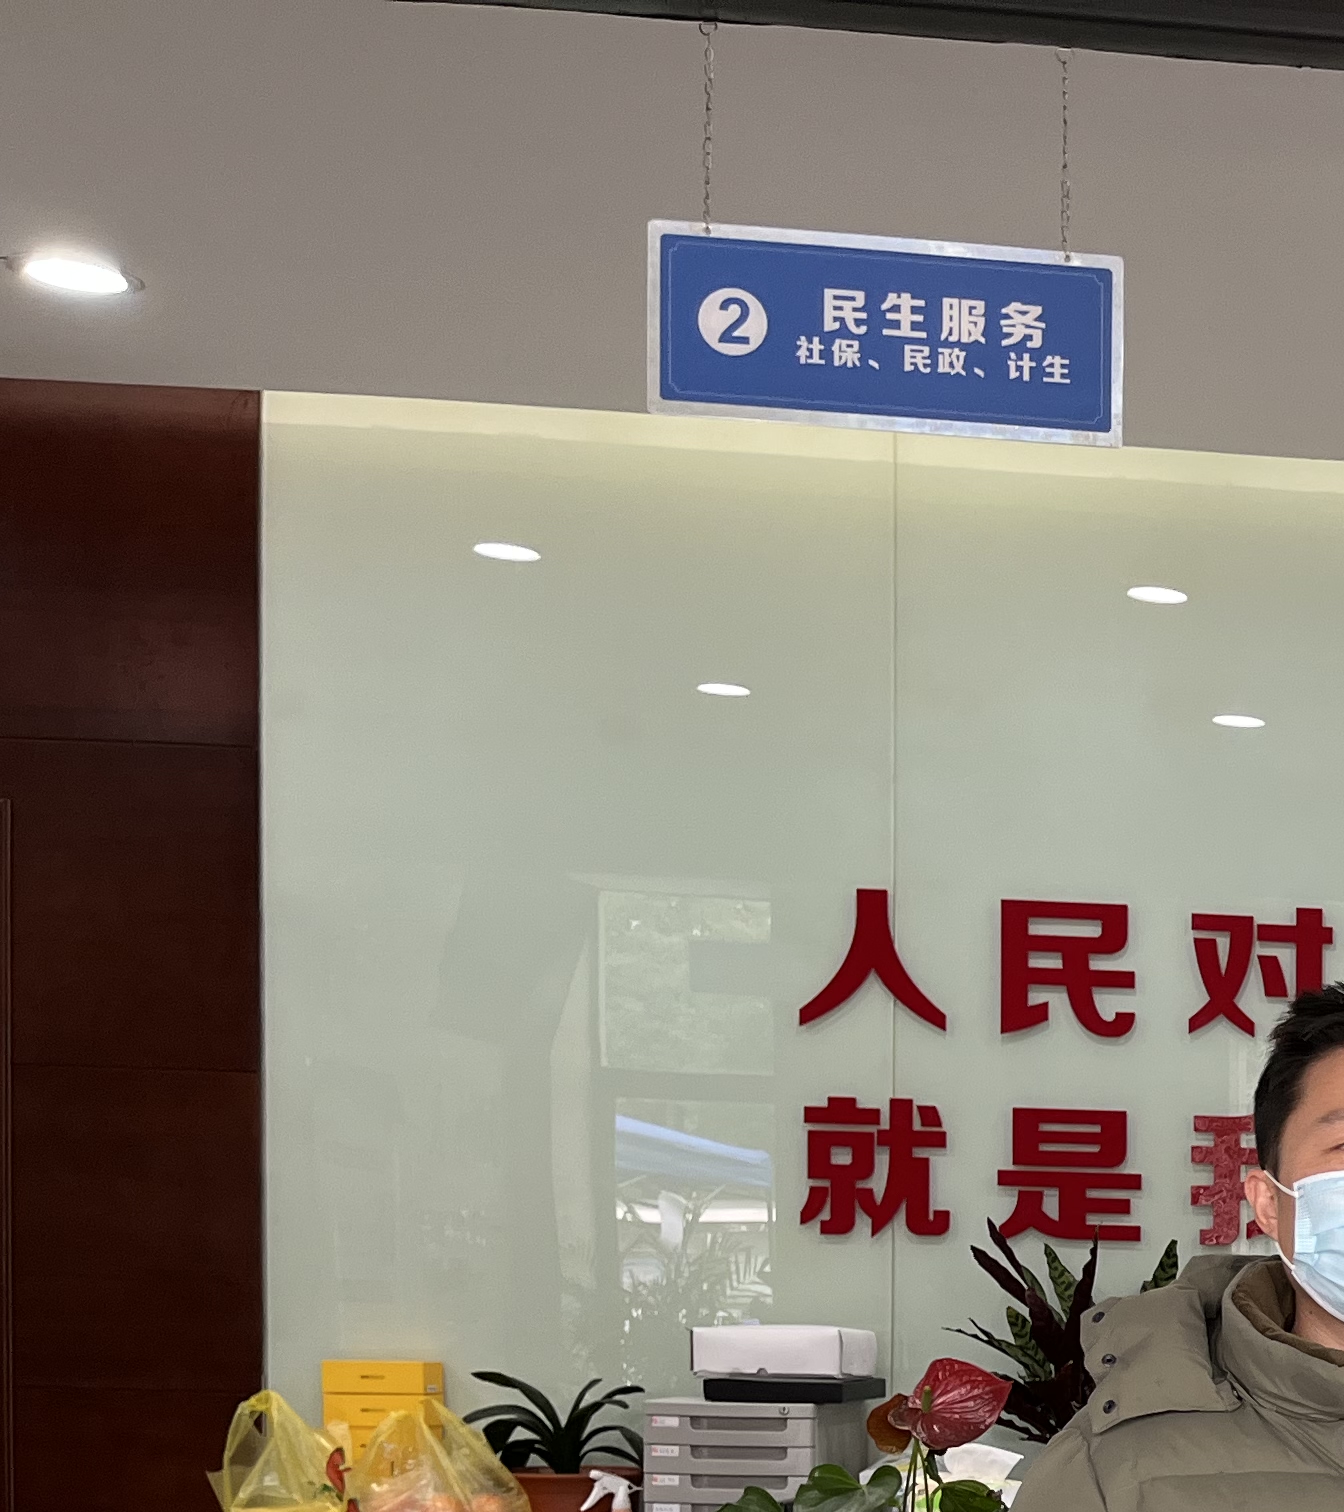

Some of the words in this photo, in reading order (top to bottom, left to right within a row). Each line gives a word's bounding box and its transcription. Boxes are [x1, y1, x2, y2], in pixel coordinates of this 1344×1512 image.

[821, 287, 1046, 350] 民生服务
[795, 336, 1071, 386] 社保、民政、计生
